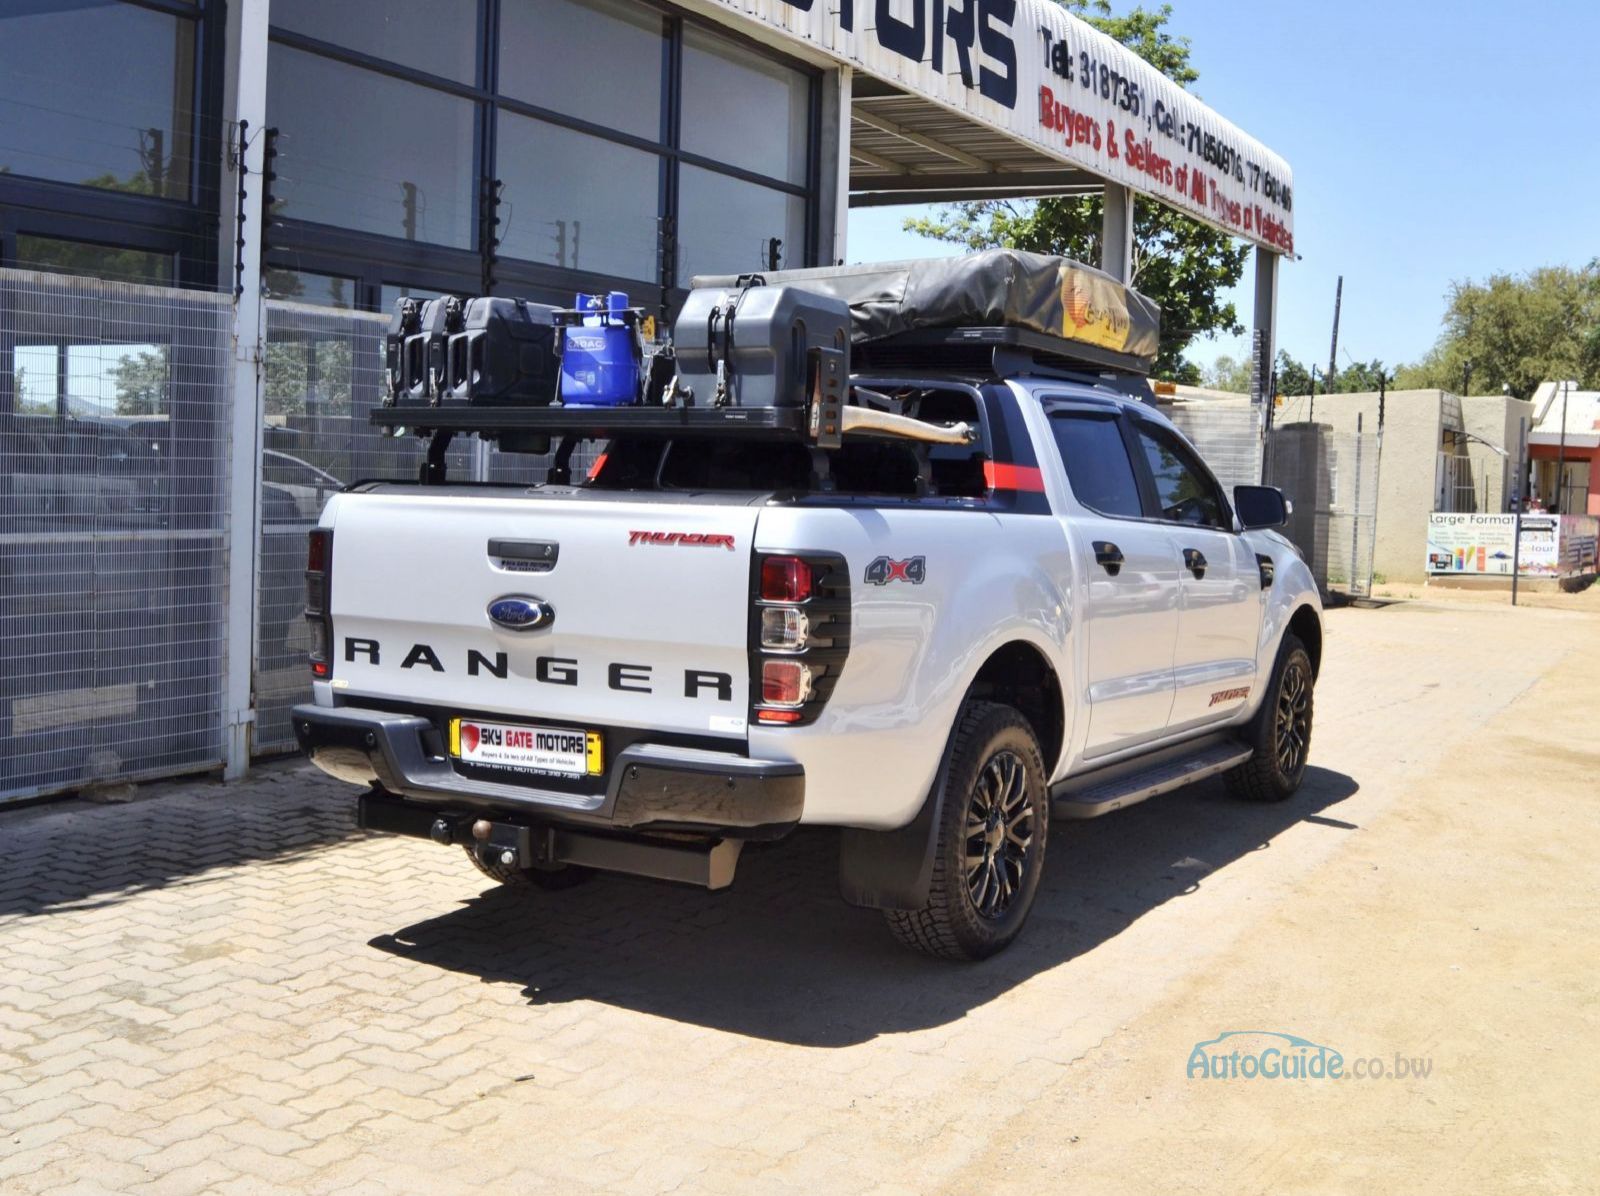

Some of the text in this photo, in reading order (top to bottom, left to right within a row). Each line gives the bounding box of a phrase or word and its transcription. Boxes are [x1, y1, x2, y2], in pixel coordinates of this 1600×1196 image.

[780, 0, 1017, 110] ORS
[1040, 85, 1101, 152] Buyers
[1107, 119, 1119, 158] &
[1125, 128, 1173, 186] Sellers
[1175, 162, 1188, 197] of
[1191, 168, 1207, 207] All
[1255, 204, 1294, 255] Vehicles
[629, 530, 735, 551] THUNDER
[1430, 515, 1465, 525] Large
[1470, 515, 1515, 524] Format
[345, 636, 732, 701] RANGER
[481, 728, 502, 747] SKY
[505, 730, 533, 749] GATE
[536, 733, 584, 754] MOTORS
